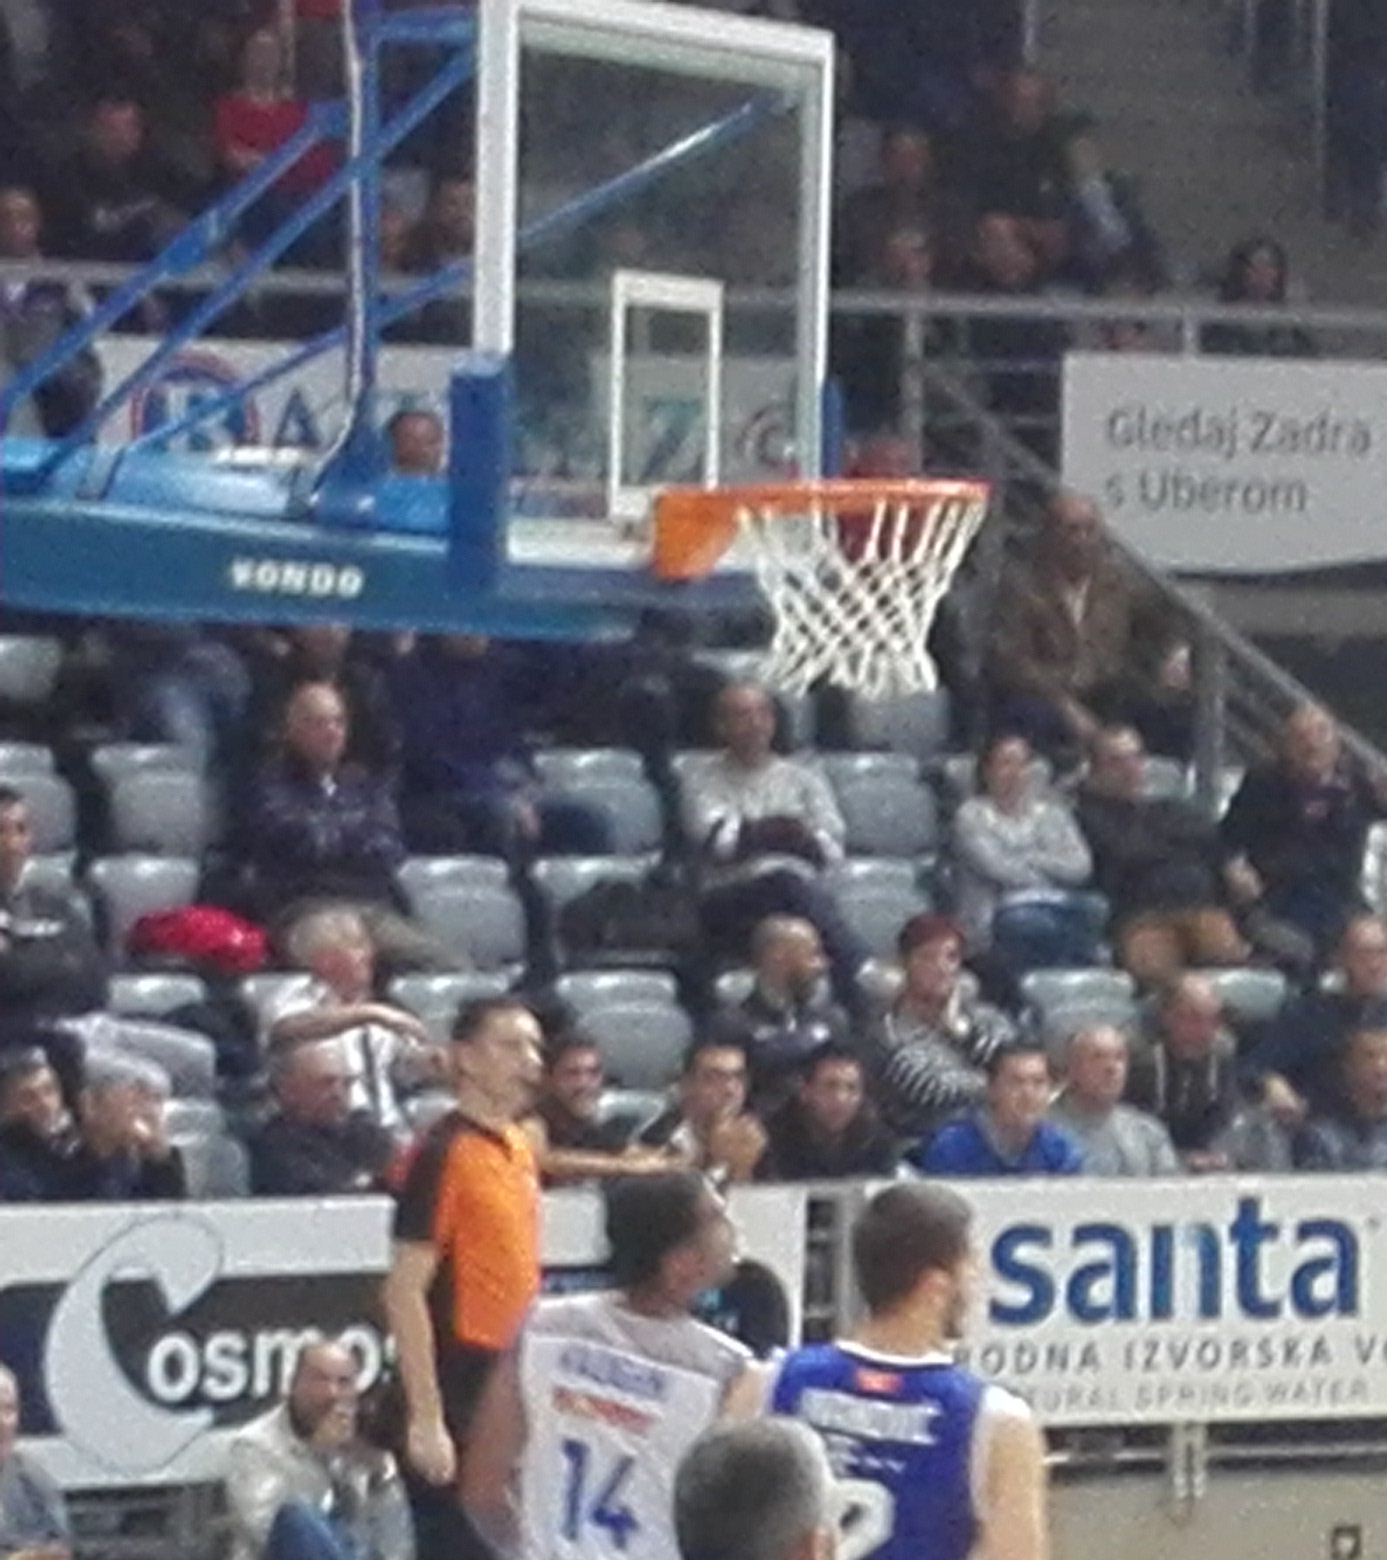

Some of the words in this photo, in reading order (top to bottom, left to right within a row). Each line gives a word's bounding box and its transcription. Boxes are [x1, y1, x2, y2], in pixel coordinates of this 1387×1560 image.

[987, 1194, 1361, 1327] santa
[44, 1213, 397, 1474] Cosmo
[1123, 1333, 1334, 1372] IZVORSKA
[561, 1437, 638, 1550] 14
